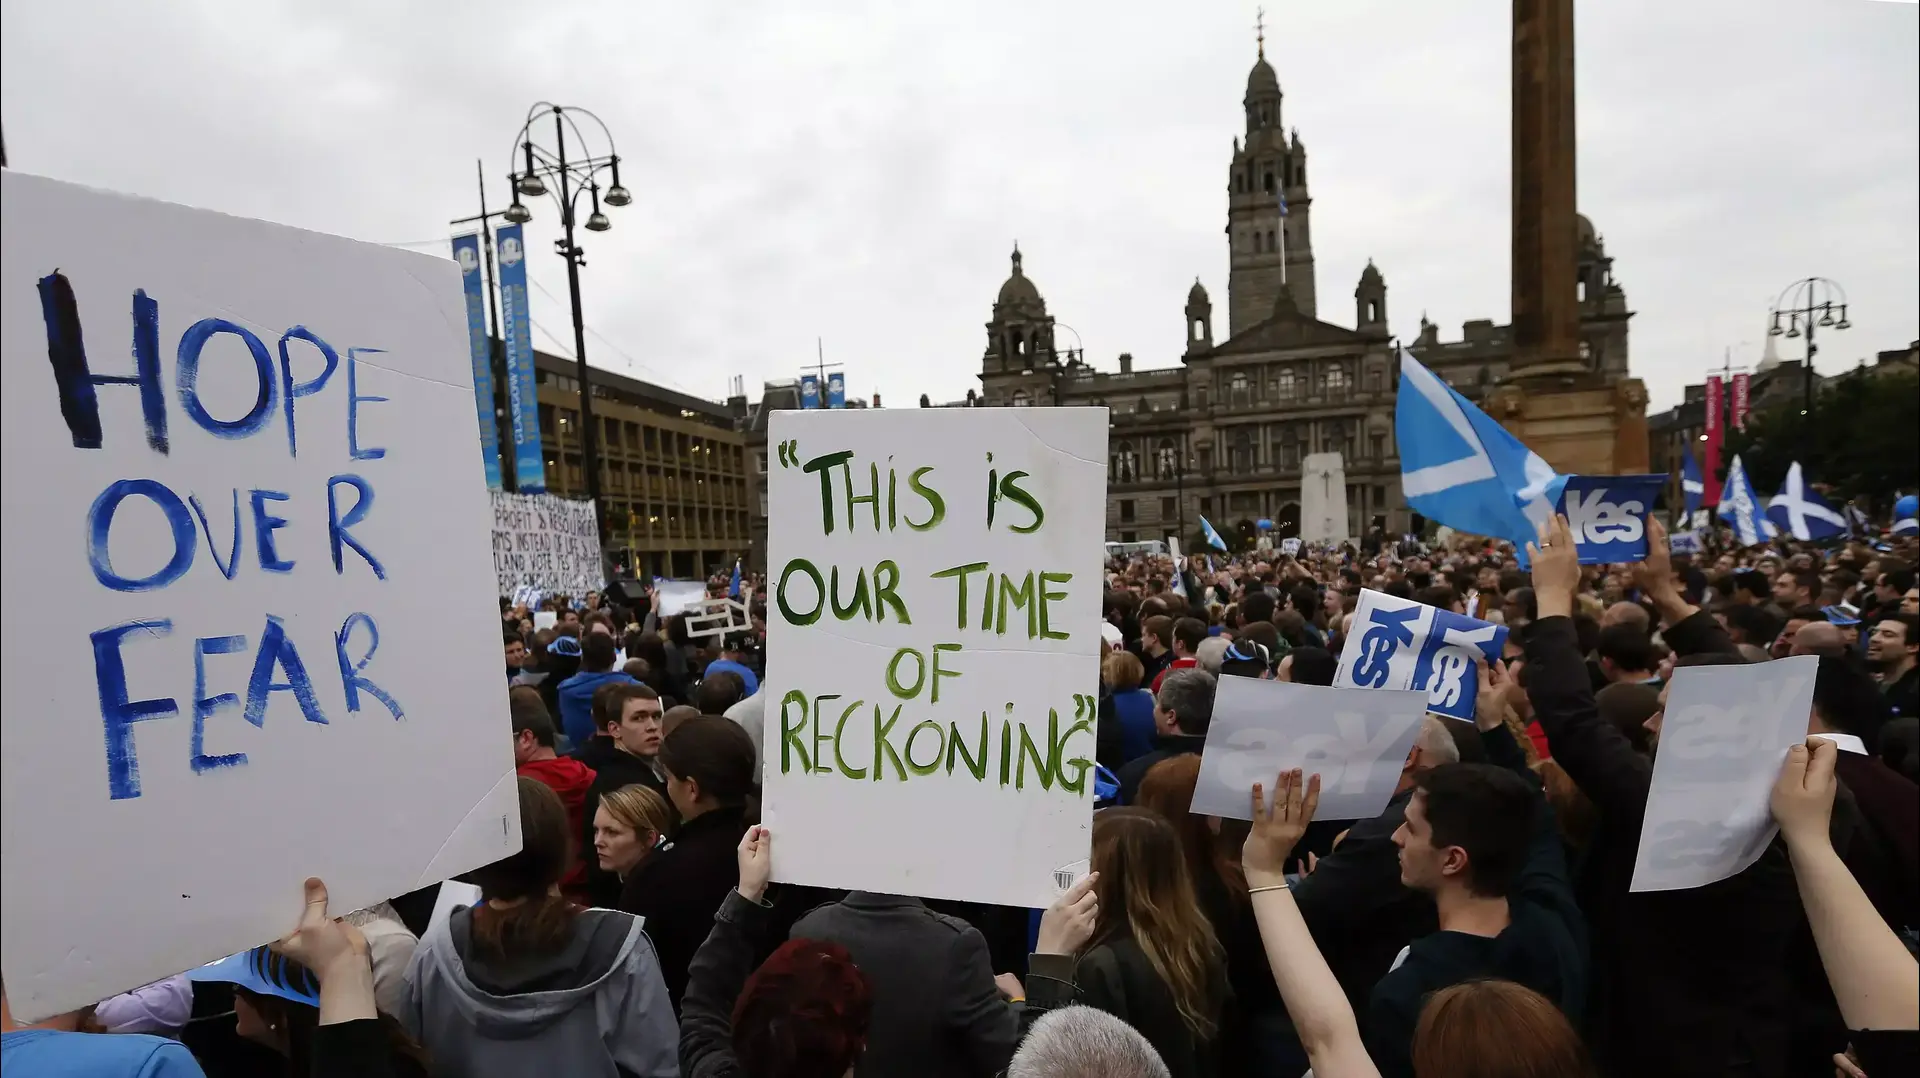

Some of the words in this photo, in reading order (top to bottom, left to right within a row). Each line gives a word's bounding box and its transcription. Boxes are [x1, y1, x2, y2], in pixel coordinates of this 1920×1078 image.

[37, 268, 388, 461] HOPE
[503, 285, 517, 368] WELCOMES
[511, 373, 525, 444] GLASGOW
[86, 473, 389, 592] OVER
[495, 508, 531, 530] PROFIT
[549, 512, 597, 537] RESOURCES
[515, 531, 551, 552] INSTEAD
[1566, 488, 1644, 545] Yes
[499, 572, 516, 592] FOR
[528, 552, 552, 572] VOTE
[556, 553, 570, 571] YES
[777, 558, 912, 626] OUR
[930, 561, 1074, 641] TIME
[886, 643, 963, 704] OF
[1352, 605, 1422, 689] Yes
[1426, 625, 1498, 708] Yes
[89, 611, 406, 801] FEAR
